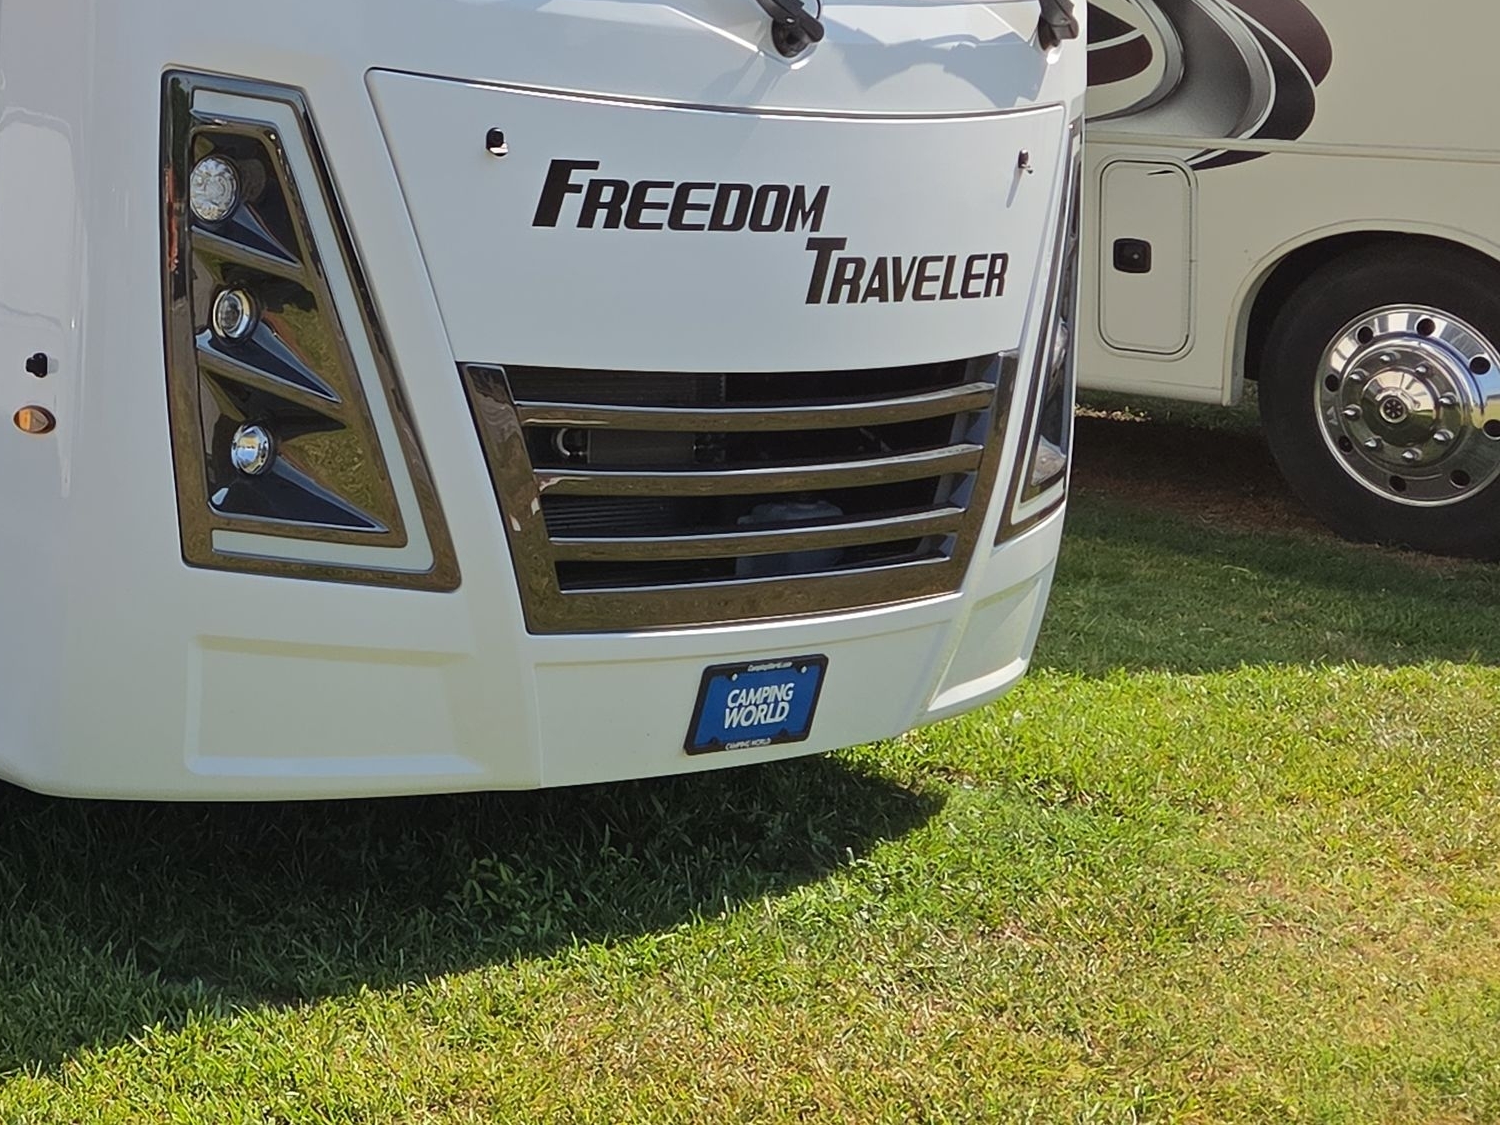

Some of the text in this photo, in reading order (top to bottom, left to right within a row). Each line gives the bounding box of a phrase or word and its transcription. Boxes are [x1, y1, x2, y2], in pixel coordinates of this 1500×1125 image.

[531, 158, 830, 233] FREEDOM
[805, 236, 1010, 305] TRAVELER
[724, 701, 790, 729] WORLD
[727, 683, 795, 708] CAMPING
